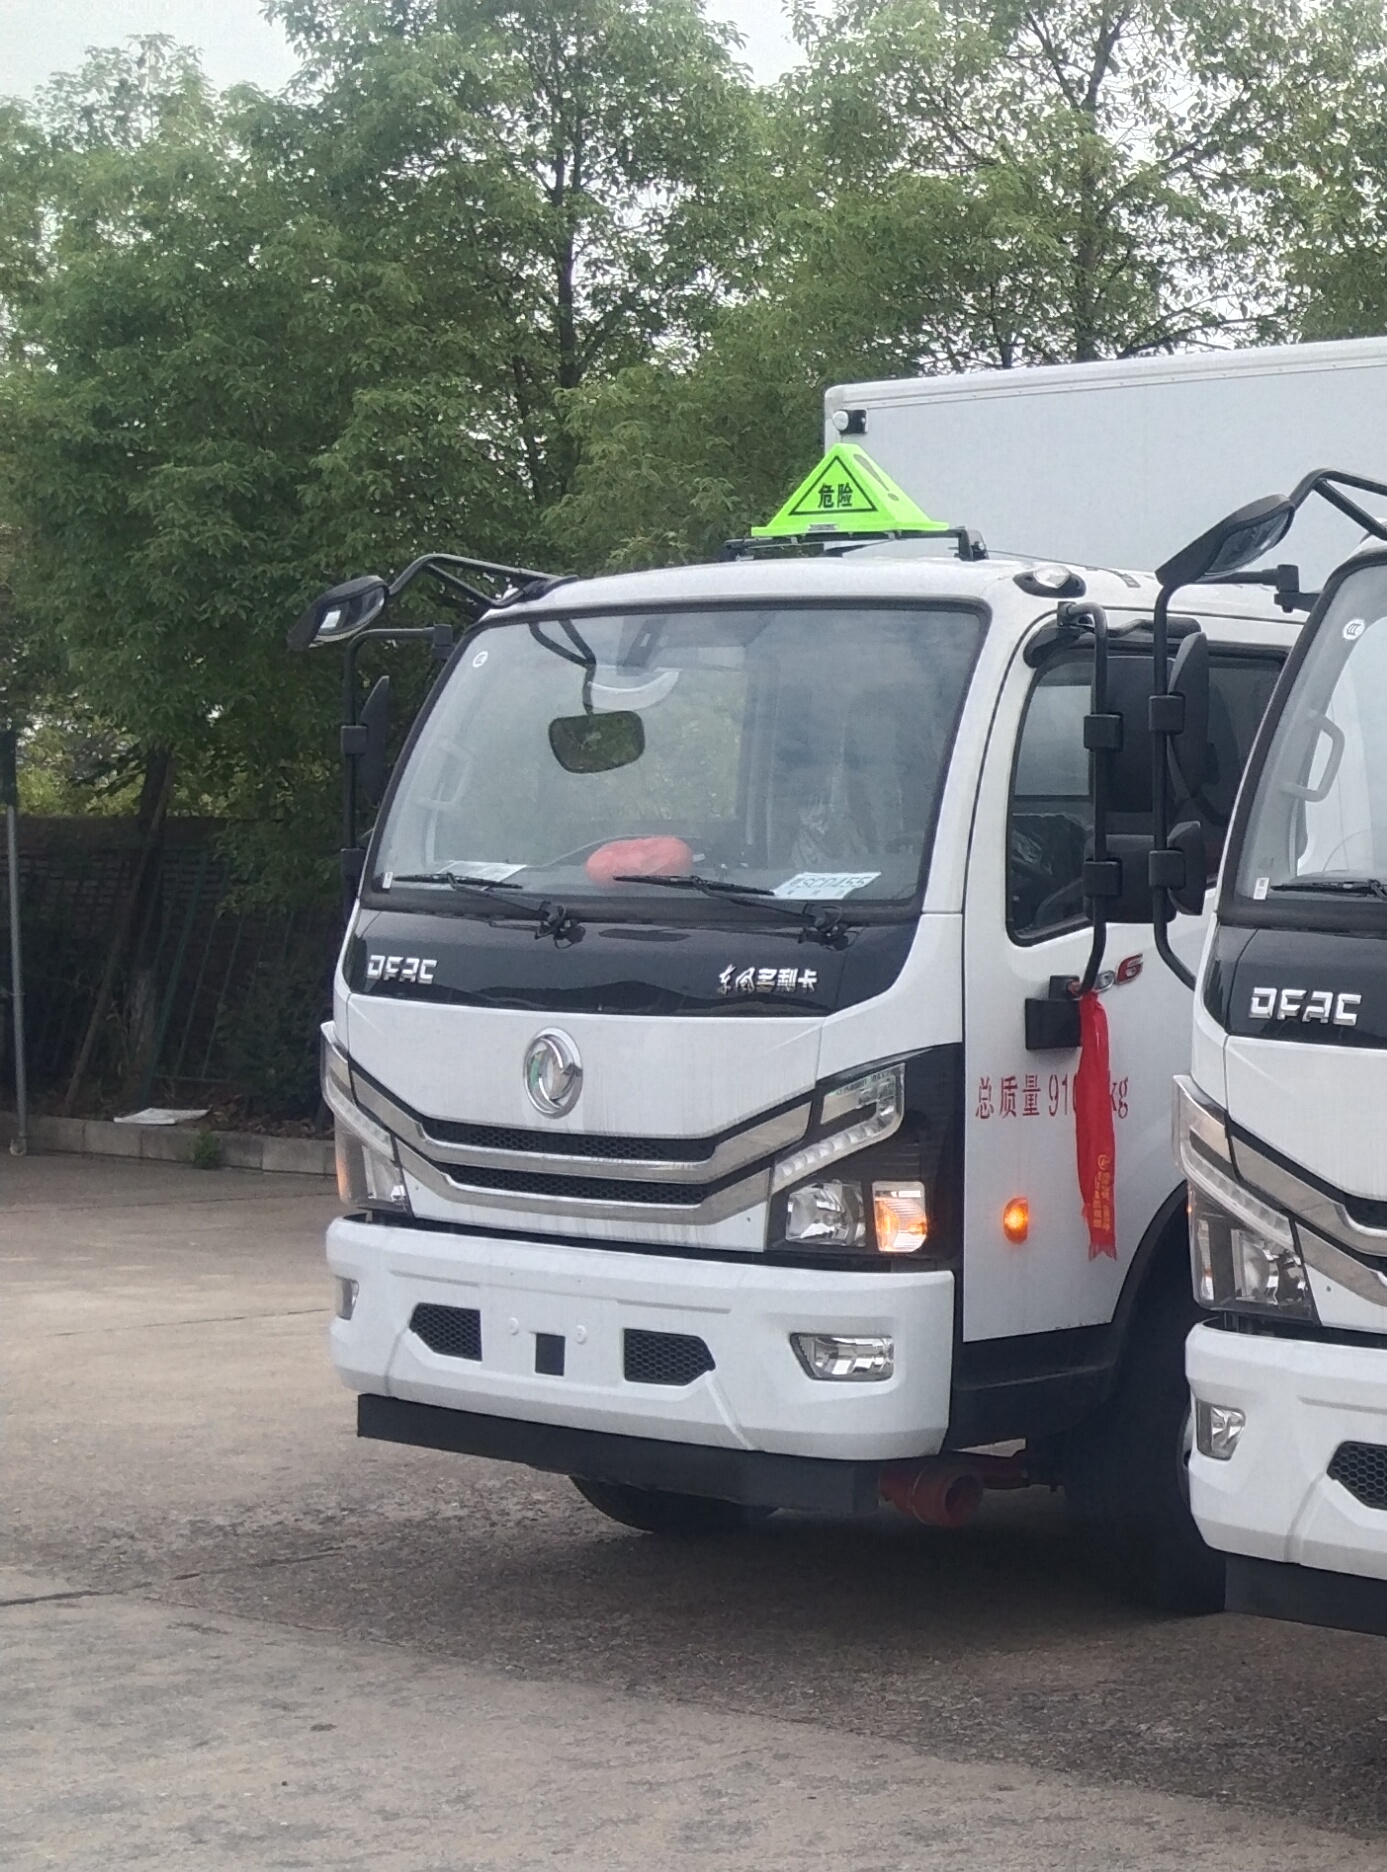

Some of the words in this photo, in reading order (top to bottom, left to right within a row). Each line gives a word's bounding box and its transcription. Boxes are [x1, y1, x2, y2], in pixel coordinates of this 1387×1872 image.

[817, 482, 853, 508] 危险
[366, 955, 437, 984] DFAC
[1248, 986, 1362, 1026] DFAC
[975, 1074, 1041, 1120] 总质量
[1048, 1074, 1078, 1117] 91
